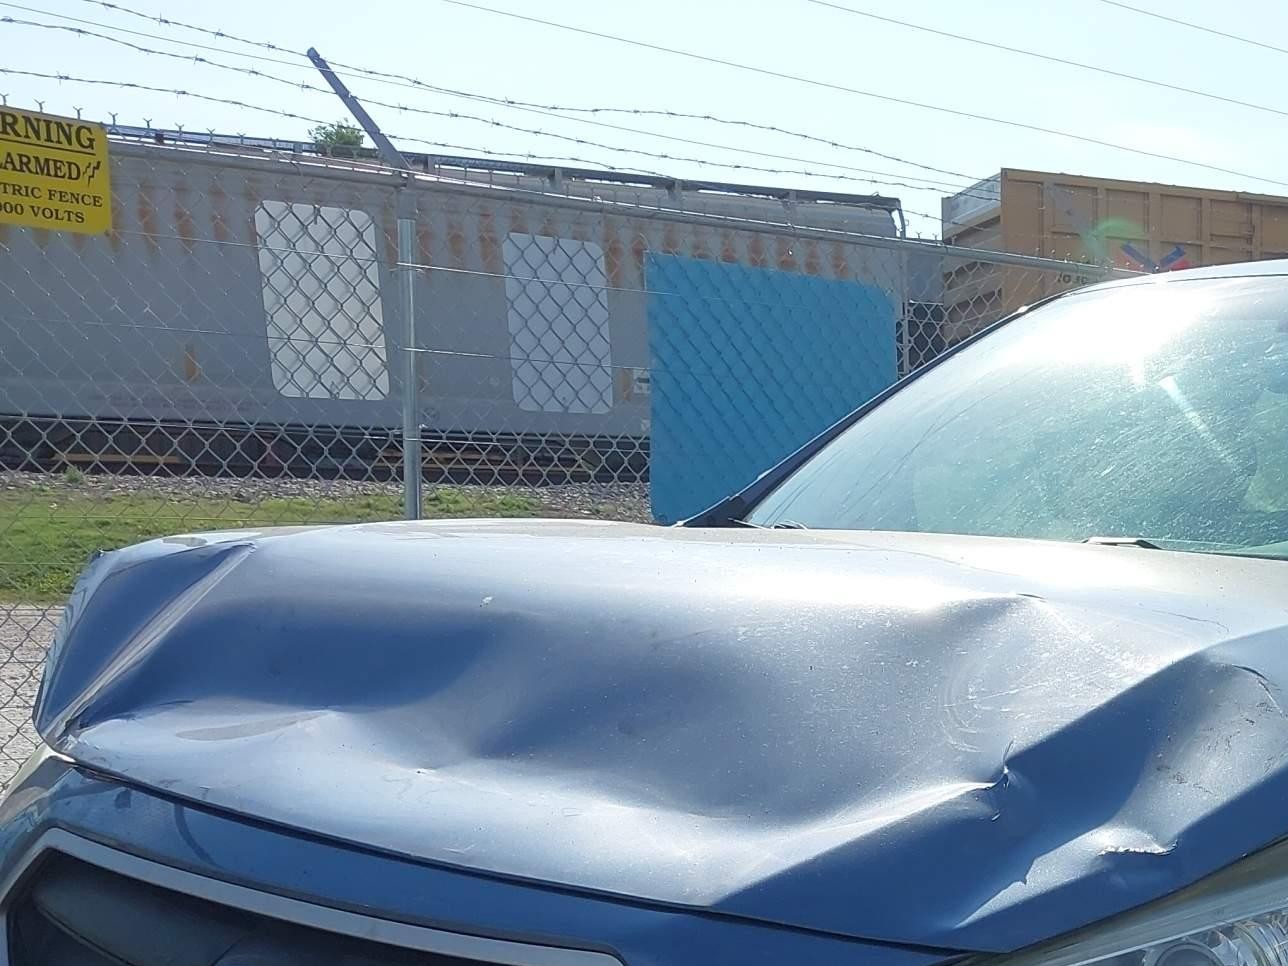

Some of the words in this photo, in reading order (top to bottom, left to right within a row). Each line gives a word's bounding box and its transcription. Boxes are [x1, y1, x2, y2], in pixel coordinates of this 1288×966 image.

[0, 151, 82, 181] ARMED
[48, 189, 103, 207] FENCE
[0, 201, 25, 216] 00
[29, 205, 86, 224] VOLTS
